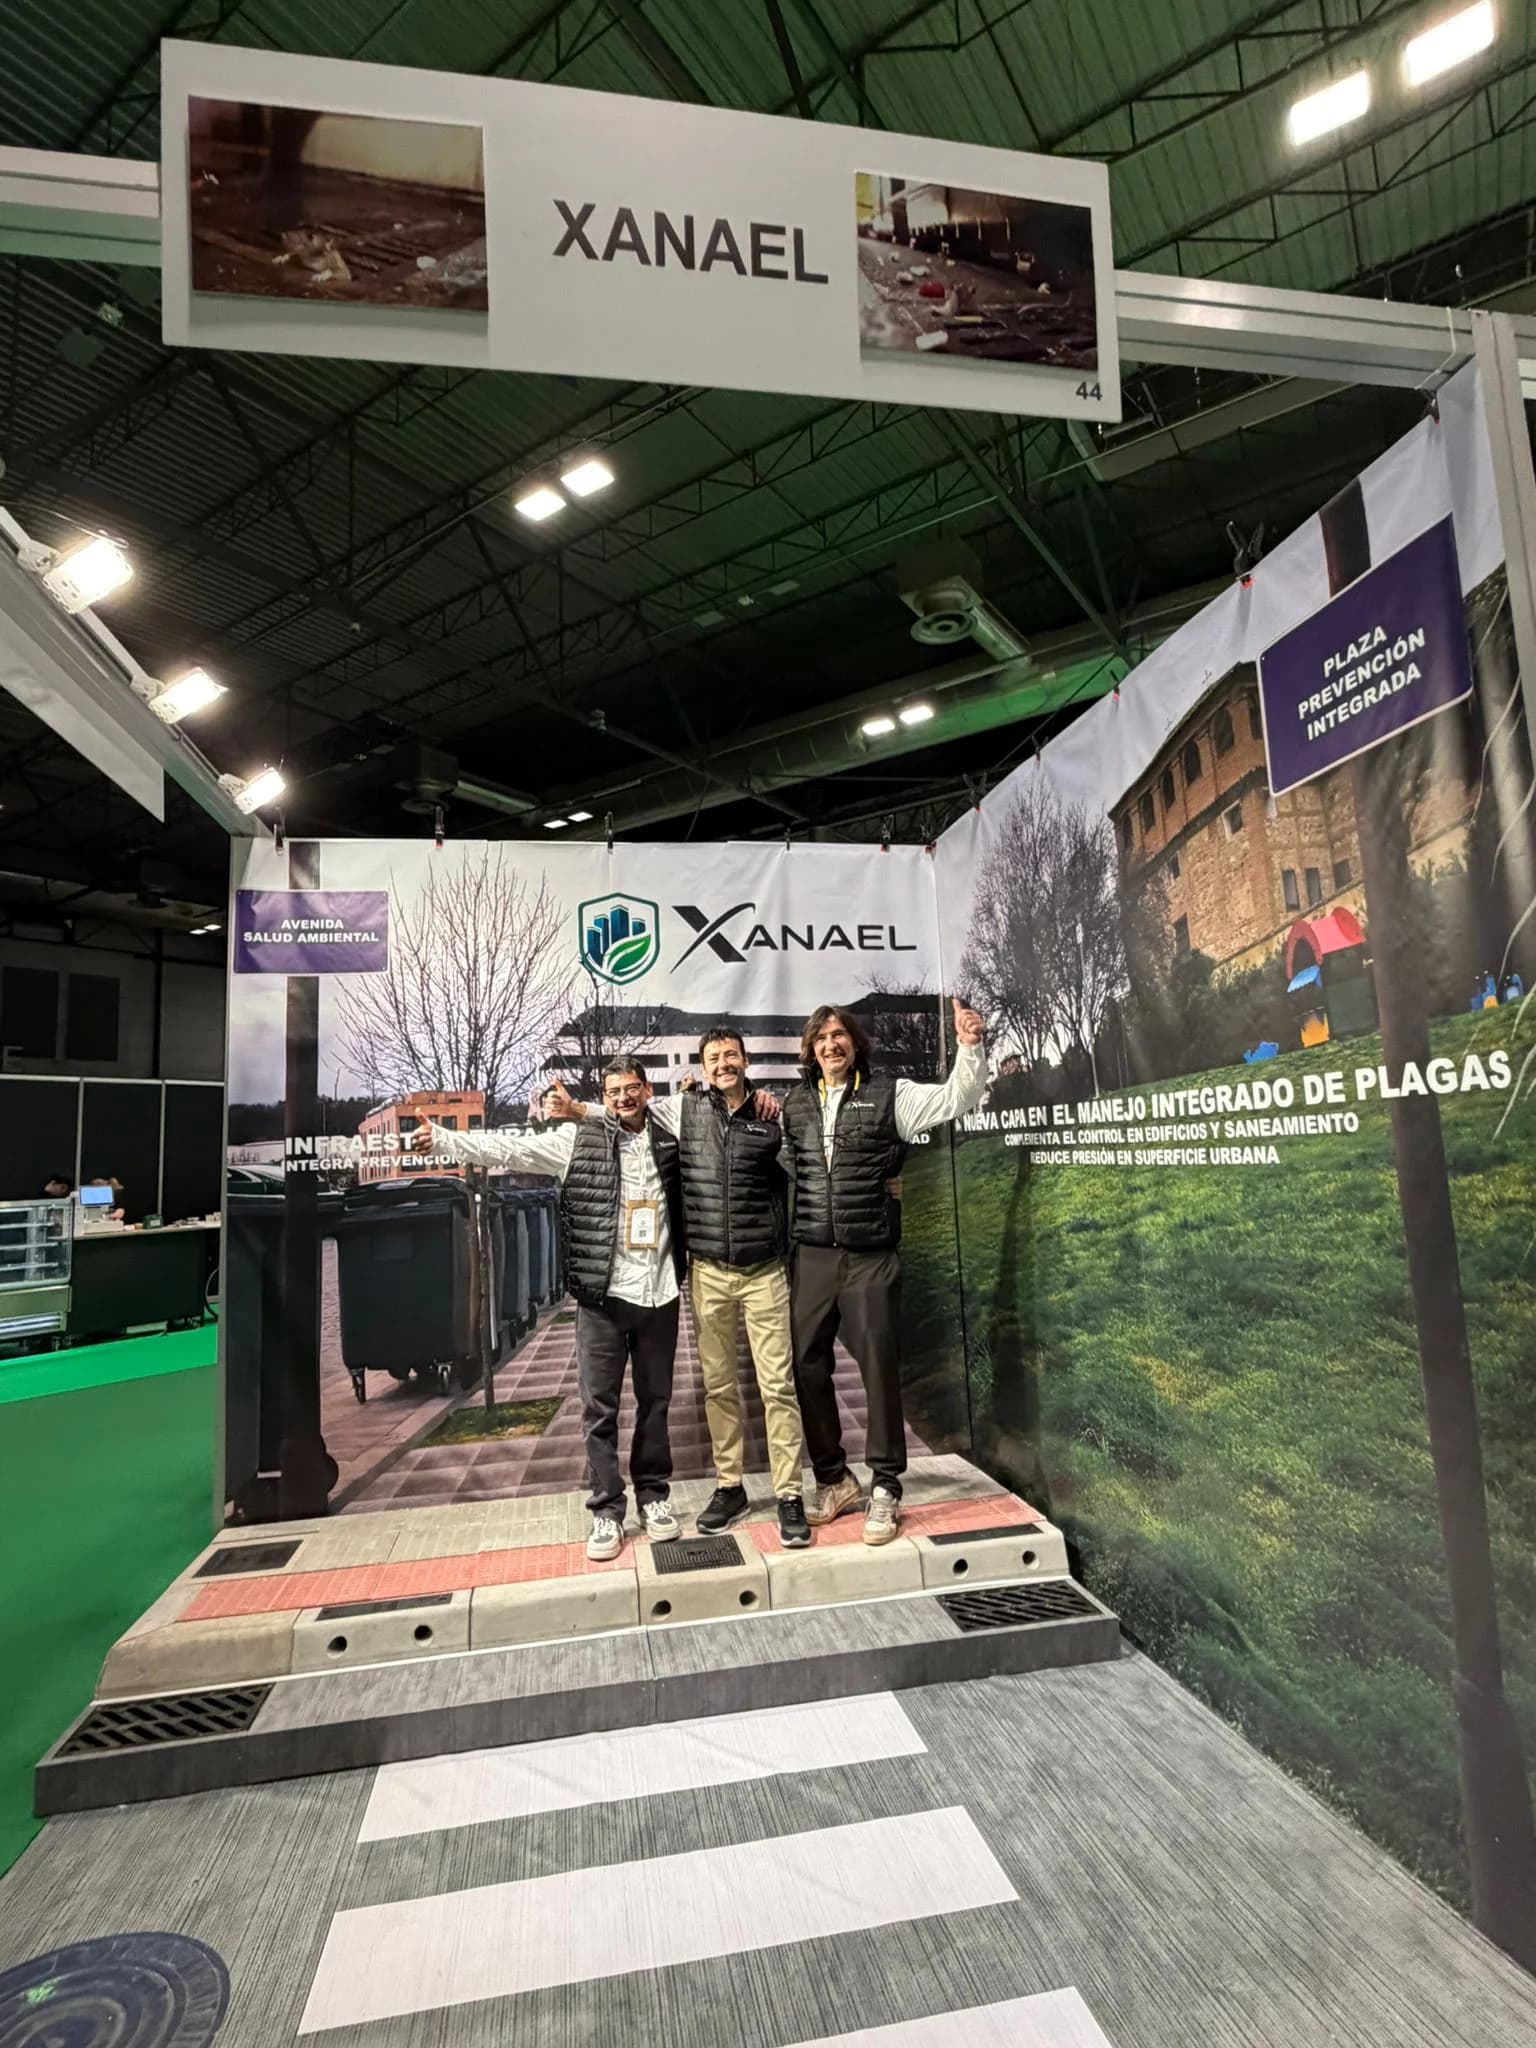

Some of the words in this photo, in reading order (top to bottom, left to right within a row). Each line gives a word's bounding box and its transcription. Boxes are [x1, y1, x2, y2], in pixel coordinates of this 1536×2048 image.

[552, 199, 829, 284] XANAEL
[1076, 381, 1103, 401] 44
[1323, 625, 1388, 678] PLAZA
[1298, 627, 1426, 720] PREVENCIÓN
[1307, 662, 1422, 741] INTEGRADA
[243, 931, 293, 943] SALUD
[296, 931, 379, 943] AMBIENTAL
[281, 919, 344, 930] AVENIDA
[670, 902, 917, 974] XANAEL
[963, 1111, 999, 1132] NUEVA
[1001, 1107, 1027, 1129] CAPA
[1028, 1105, 1048, 1127] EN
[1053, 1102, 1075, 1125] EL
[1077, 1095, 1146, 1124] MANEJO
[1151, 1078, 1294, 1119] INTEGRADO
[1303, 1071, 1346, 1105] DE
[1355, 1050, 1512, 1101] PLAGAS
[1062, 1130, 1076, 1144] EL
[1077, 1128, 1126, 1144] CONTROL
[1127, 1127, 1144, 1143] EN
[1145, 1122, 1207, 1142] EDIFICIOS
[1210, 1120, 1221, 1139] Y
[1224, 1111, 1359, 1139] SANEAMIENTO
[281, 1157, 354, 1172] INTEGRA
[1030, 1150, 1070, 1165] REDUCE
[1072, 1147, 1115, 1165] PRESIÓN
[1116, 1150, 1133, 1165] EN
[1134, 1148, 1207, 1166] SUPERFICIE
[1210, 1145, 1280, 1165] URBANA
